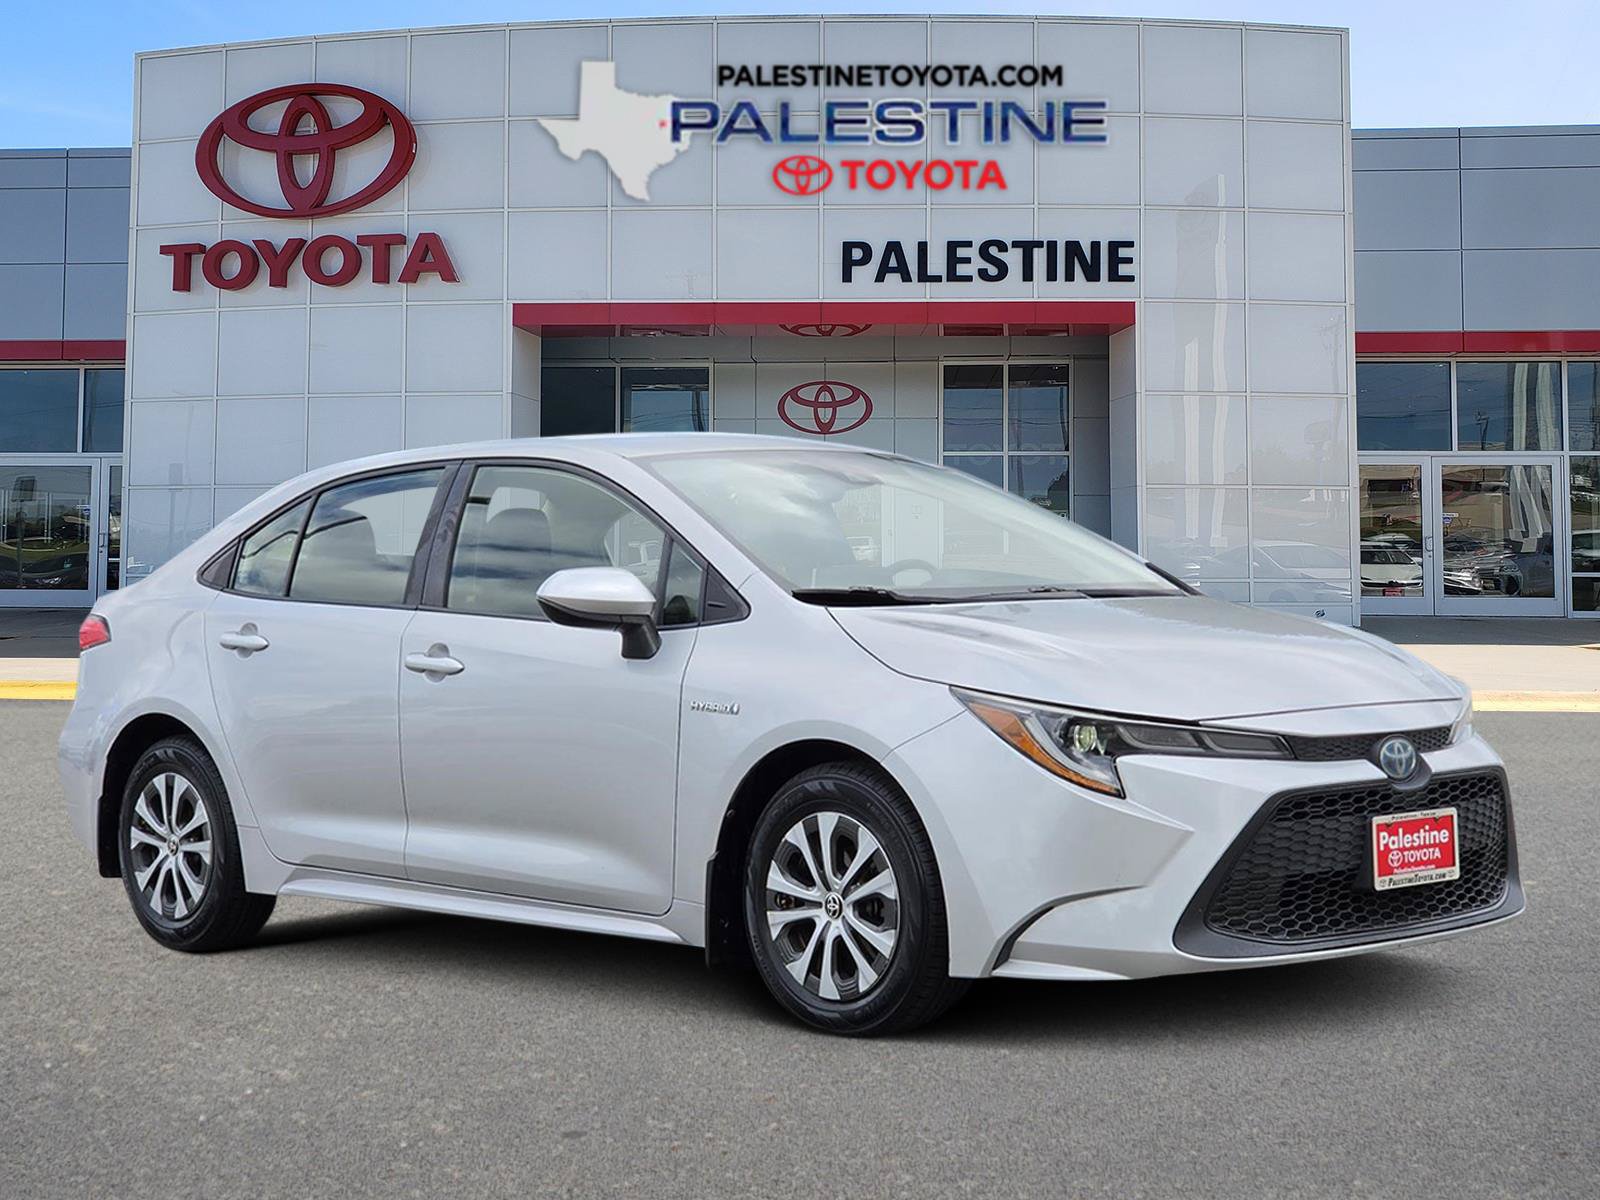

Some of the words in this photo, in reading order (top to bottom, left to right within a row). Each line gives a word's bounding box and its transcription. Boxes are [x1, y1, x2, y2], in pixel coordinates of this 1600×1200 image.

[159, 231, 461, 293] TOYOTA
[842, 239, 1136, 283] PALESTINE
[1379, 825, 1449, 851] Palestine
[1403, 847, 1441, 863] TOYOTA
